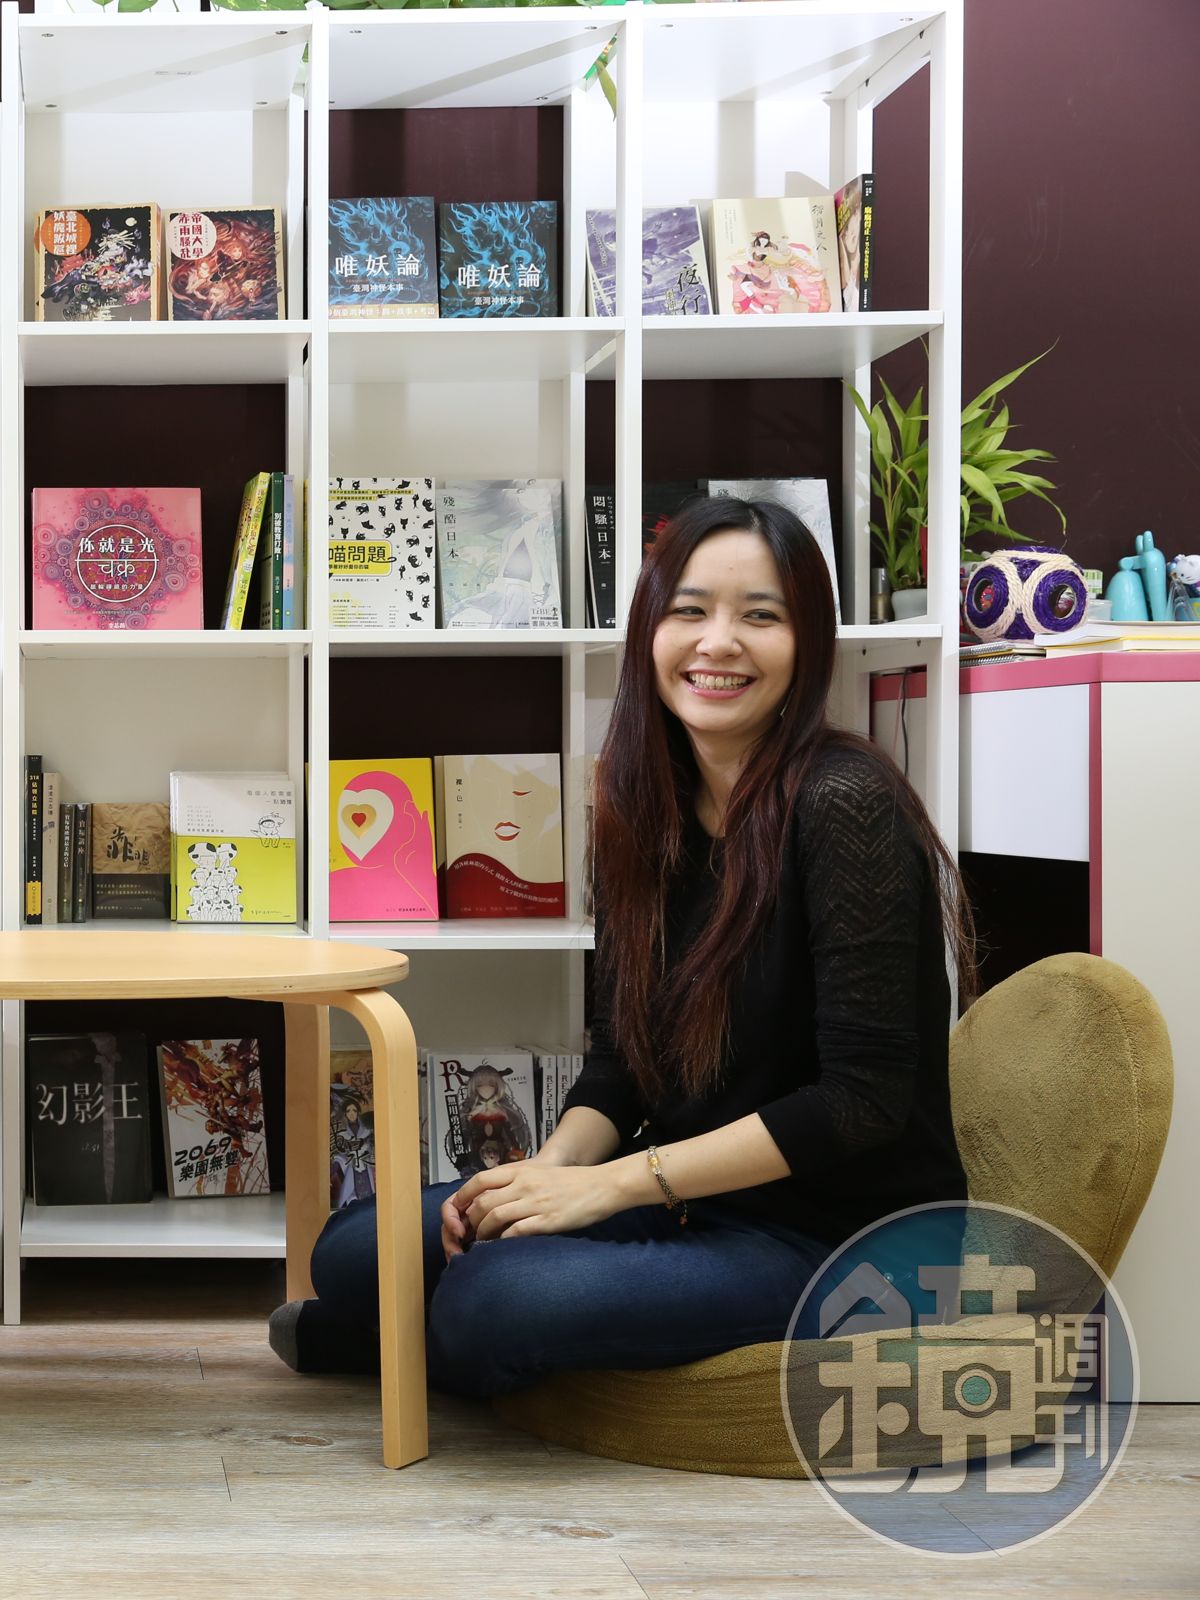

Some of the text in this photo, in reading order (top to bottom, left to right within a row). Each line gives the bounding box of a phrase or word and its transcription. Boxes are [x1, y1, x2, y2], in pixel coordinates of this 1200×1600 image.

[53, 211, 65, 255] 妖魔跋扈
[66, 211, 78, 255] 臺北城裡
[191, 213, 203, 258] 帝國大學
[335, 254, 420, 277] 唯妖論
[458, 263, 541, 288] 唯妖論
[79, 537, 155, 553] 你就是光
[443, 496, 460, 560] 殘酷日本
[593, 495, 612, 560] 悶騷日本
[36, 1082, 143, 1126] 幻影王
[174, 1136, 233, 1167] 2069
[178, 1150, 240, 1182] 樂園無雙
